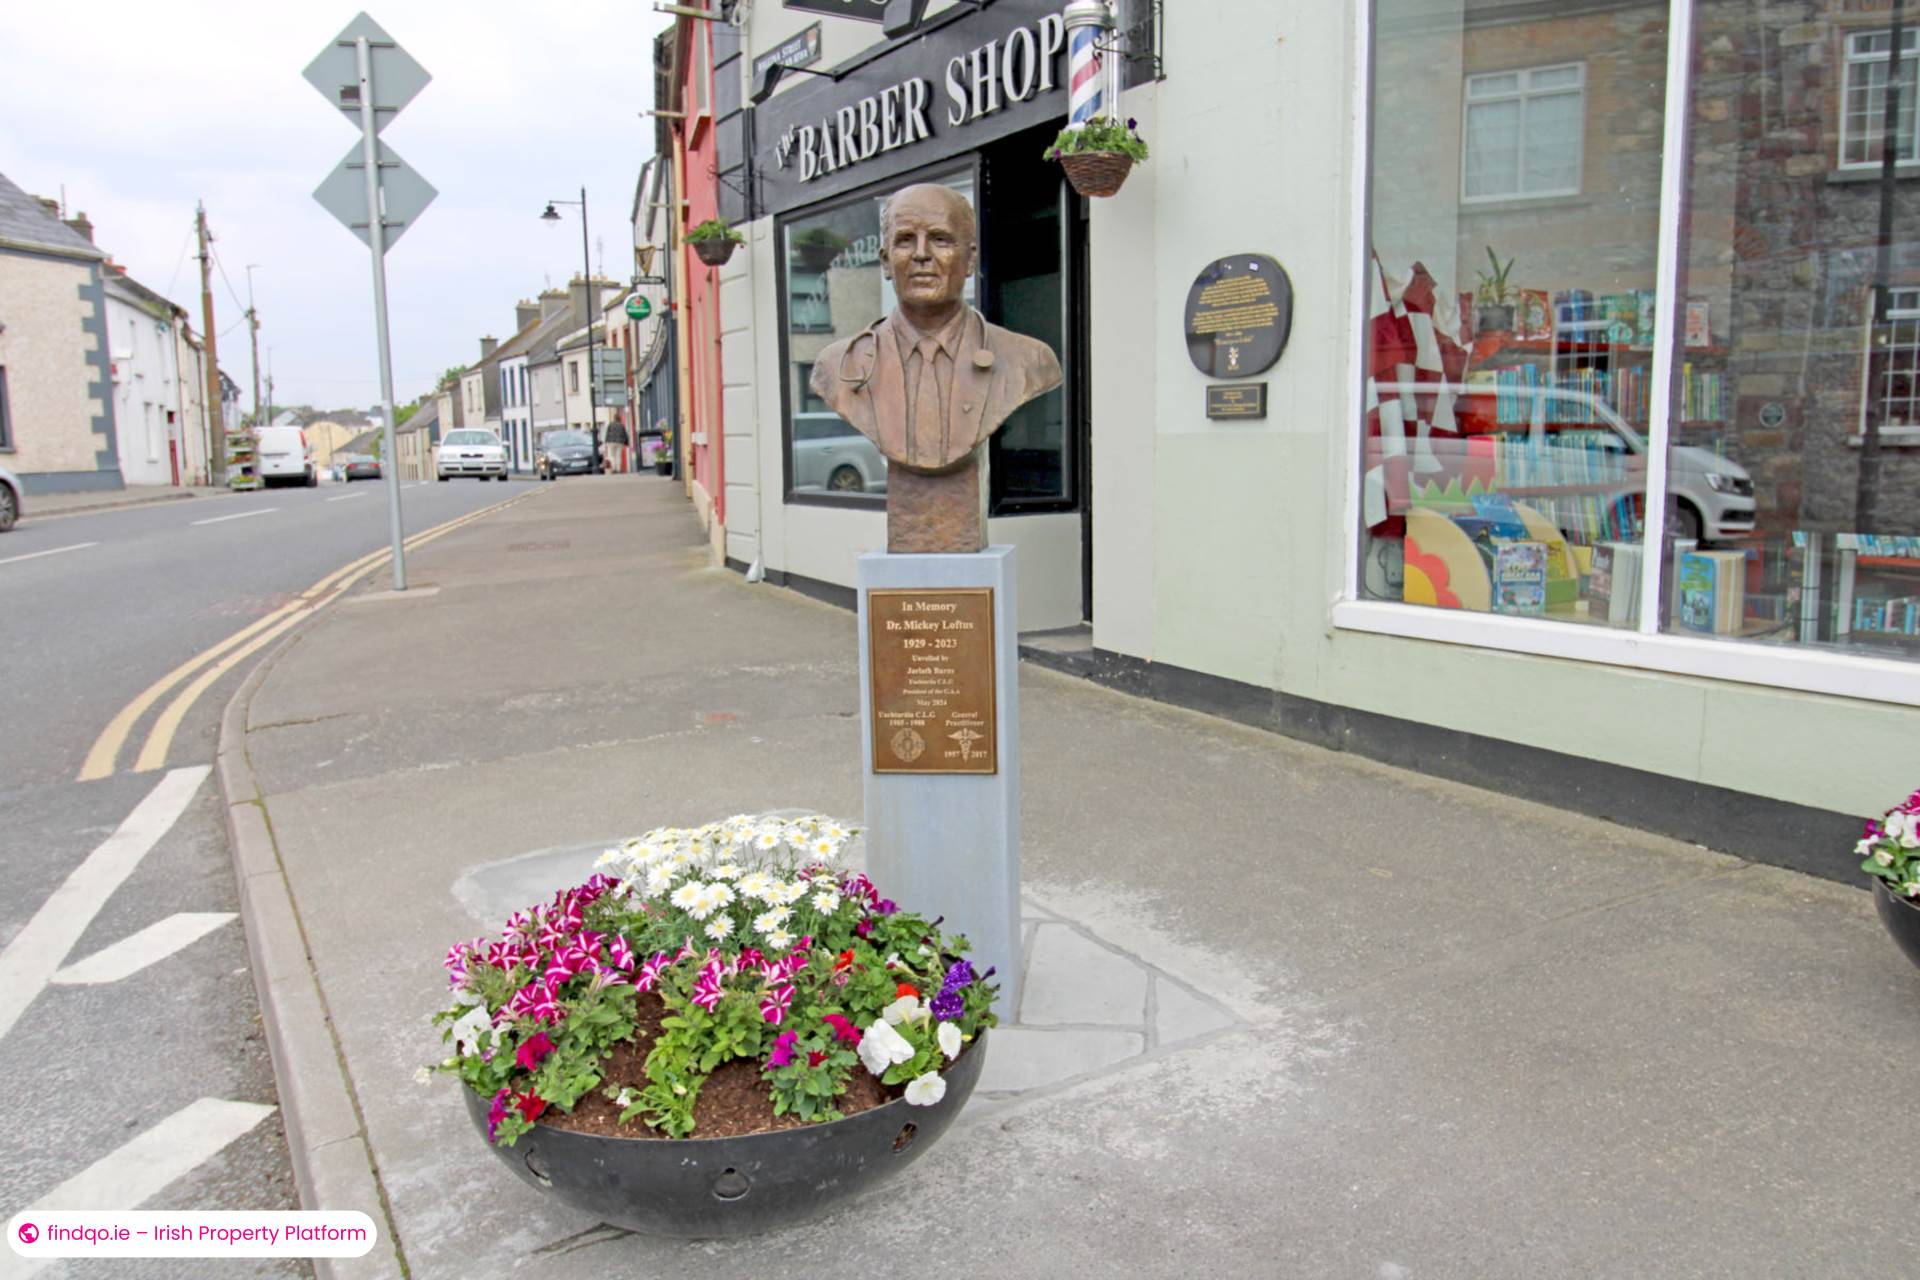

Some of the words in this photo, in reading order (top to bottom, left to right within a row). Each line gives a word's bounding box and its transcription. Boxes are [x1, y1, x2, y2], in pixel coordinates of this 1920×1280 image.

[799, 77, 929, 183] BARBER
[944, 12, 1065, 127] SHOP
[902, 601, 913, 612] In
[915, 601, 957, 613] Memory
[886, 620, 902, 630] Dr.
[903, 620, 940, 632] Mickey
[942, 620, 974, 630] Loftus
[903, 639, 926, 649] 1929
[934, 639, 958, 649] 2023
